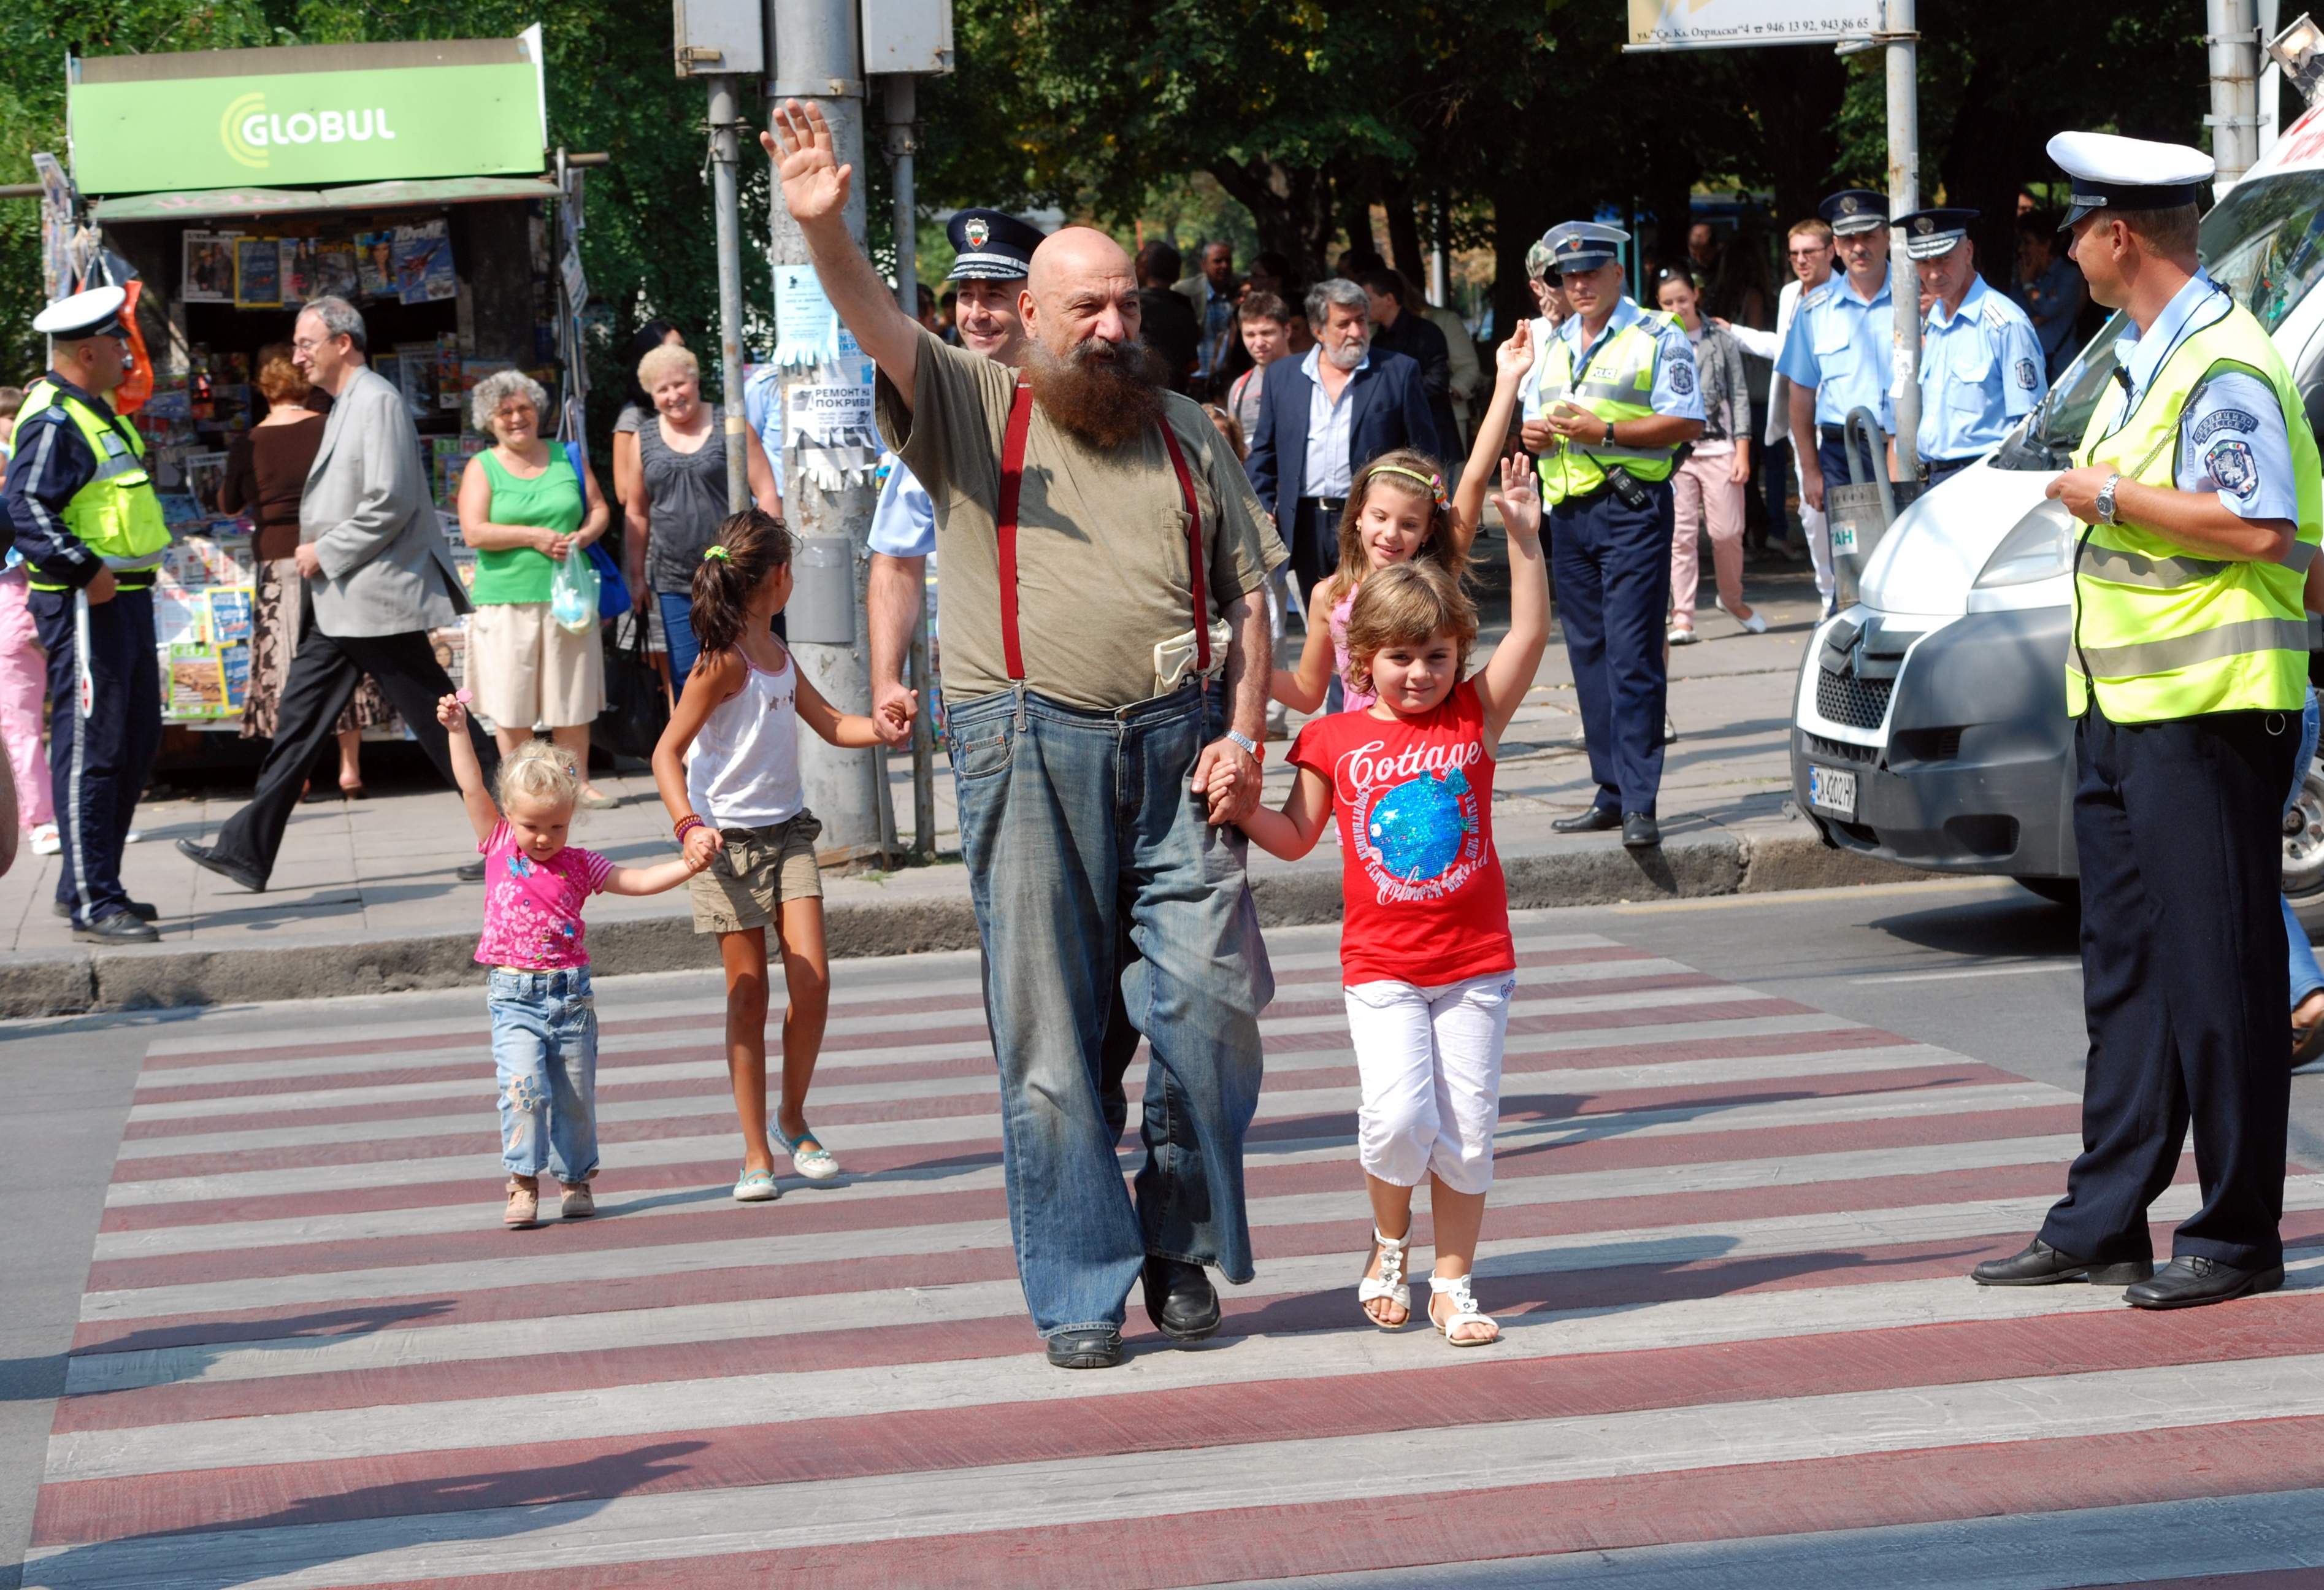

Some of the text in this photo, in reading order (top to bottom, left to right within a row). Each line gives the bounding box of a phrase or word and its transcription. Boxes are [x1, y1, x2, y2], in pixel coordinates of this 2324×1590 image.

[1766, 22, 1784, 33] 946
[1789, 21, 1799, 31] 13
[1803, 20, 1818, 31] 92,
[1821, 20, 1838, 30] 943
[1842, 18, 1854, 29] 86
[1857, 18, 1869, 28] 65
[242, 108, 396, 147] GLOBUL
[815, 388, 860, 398] РЕМОНТ
[816, 398, 871, 408] ПОКРИВИ
[1335, 740, 1482, 805] Cottage
[1465, 793, 1479, 835] WINTER
[1465, 837, 1479, 860] GIRL
